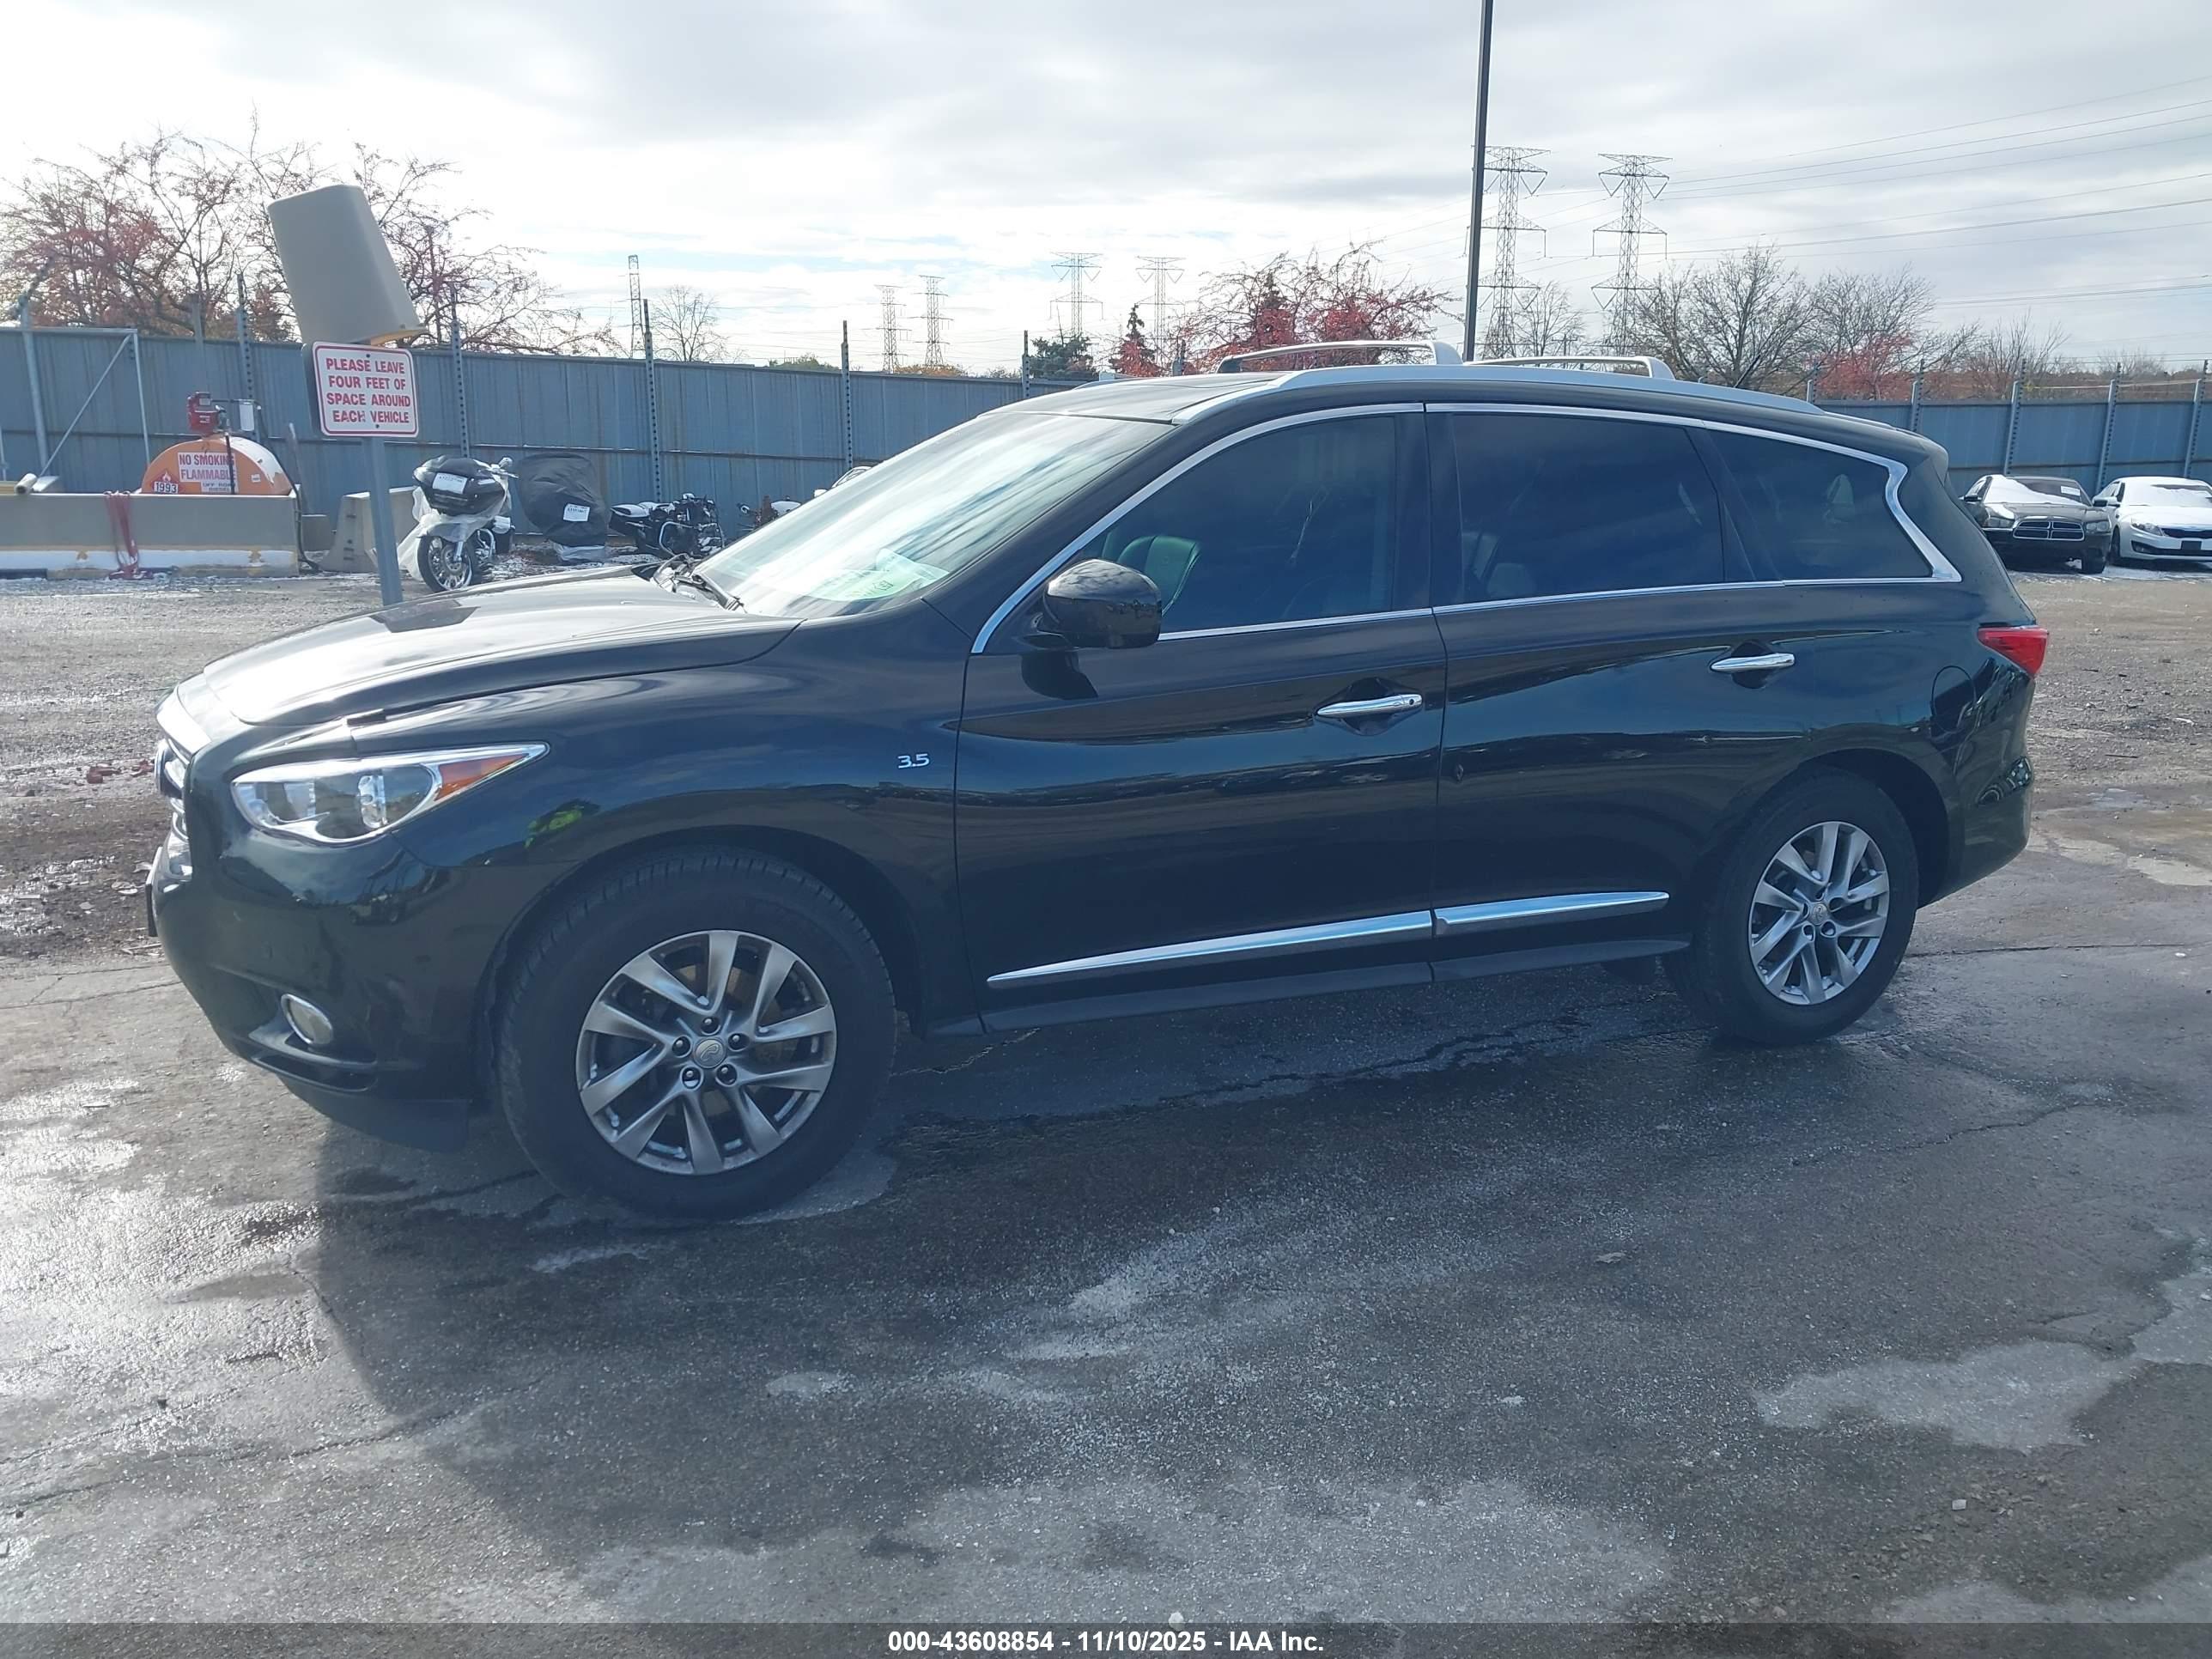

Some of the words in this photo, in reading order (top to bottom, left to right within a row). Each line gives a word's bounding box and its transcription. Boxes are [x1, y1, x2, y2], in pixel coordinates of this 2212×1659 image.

[326, 357, 372, 372] PLEASE
[374, 361, 405, 374] LEAVE
[328, 375, 361, 388] FOUR
[365, 376, 390, 390] FEET
[393, 379, 406, 390] OF
[326, 392, 366, 405] SPACE
[371, 395, 410, 407] AROUND
[332, 410, 366, 422] EACH
[370, 410, 410, 423] VEHICLE
[179, 454, 192, 465] NO
[155, 482, 177, 493] 1993
[897, 753, 930, 769] 3.5
